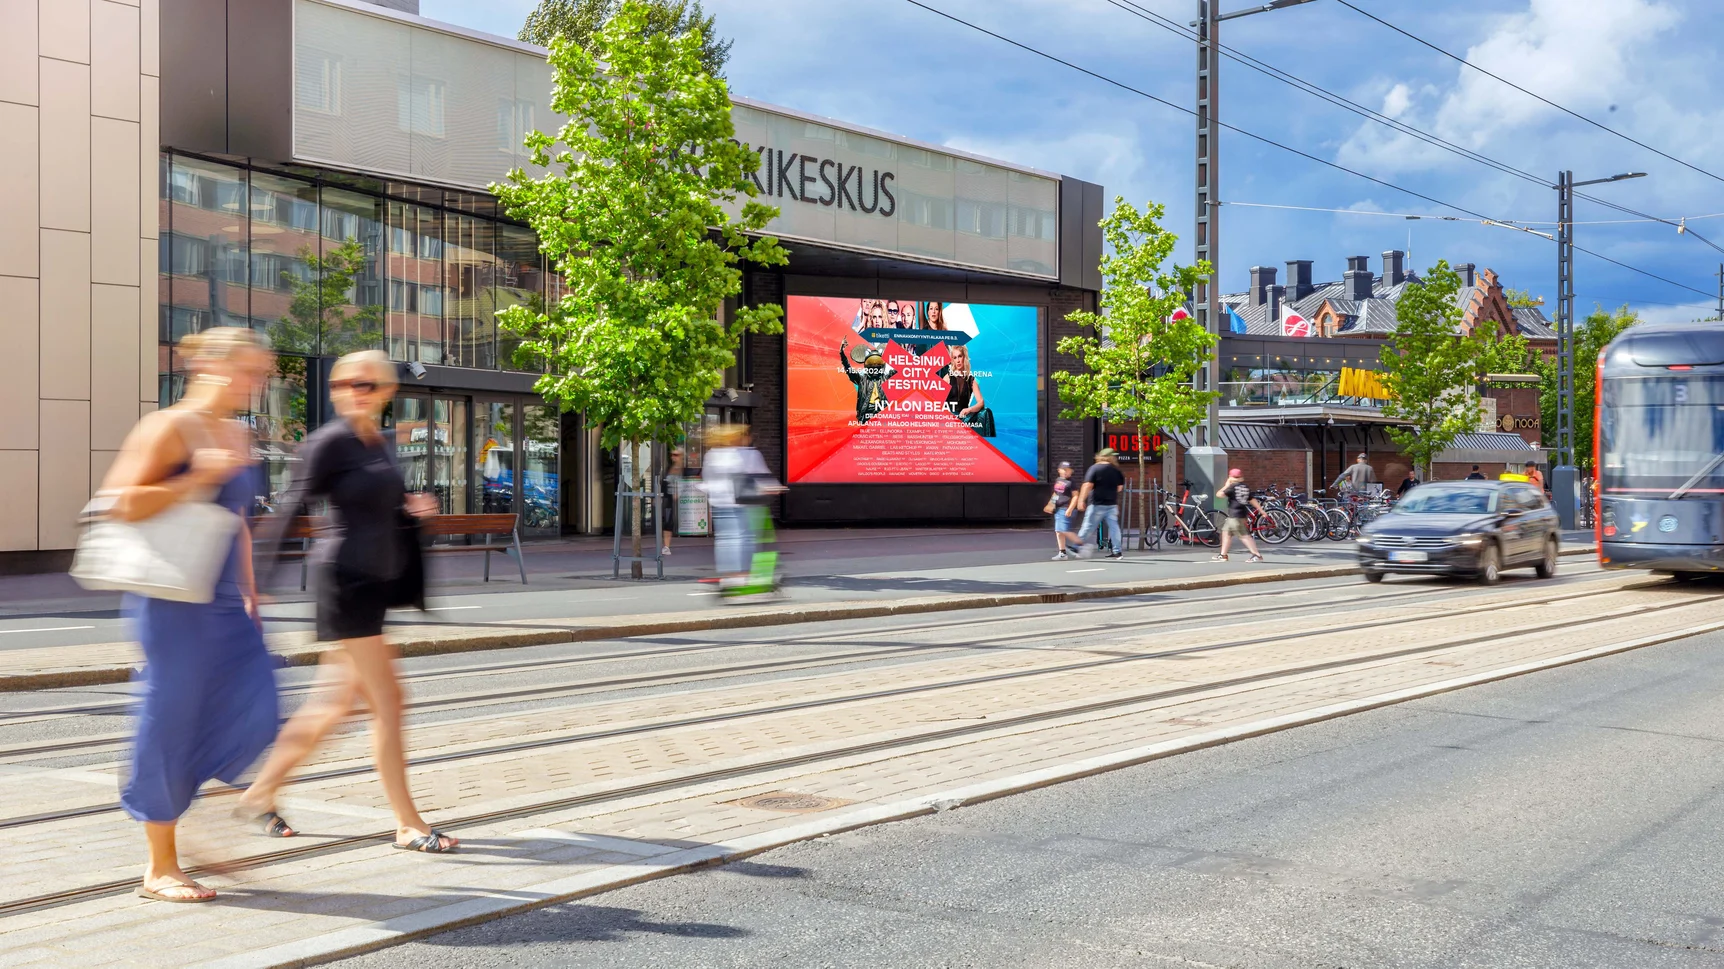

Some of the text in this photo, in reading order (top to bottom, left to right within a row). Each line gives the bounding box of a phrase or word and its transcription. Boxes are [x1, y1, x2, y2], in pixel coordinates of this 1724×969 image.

[664, 130, 897, 218] KIKESKUS
[888, 354, 945, 367] HELSINKI
[902, 367, 931, 378] CITY
[968, 370, 993, 378] ARENA
[888, 379, 945, 391] FESTIVAL
[1674, 384, 1689, 402] 3
[874, 400, 959, 413] NYLON BEAT
[935, 413, 959, 421] SCHULZ
[887, 420, 910, 428] HALOO
[944, 421, 983, 429] GETTOMASA
[1108, 434, 1162, 452] ROSSO
